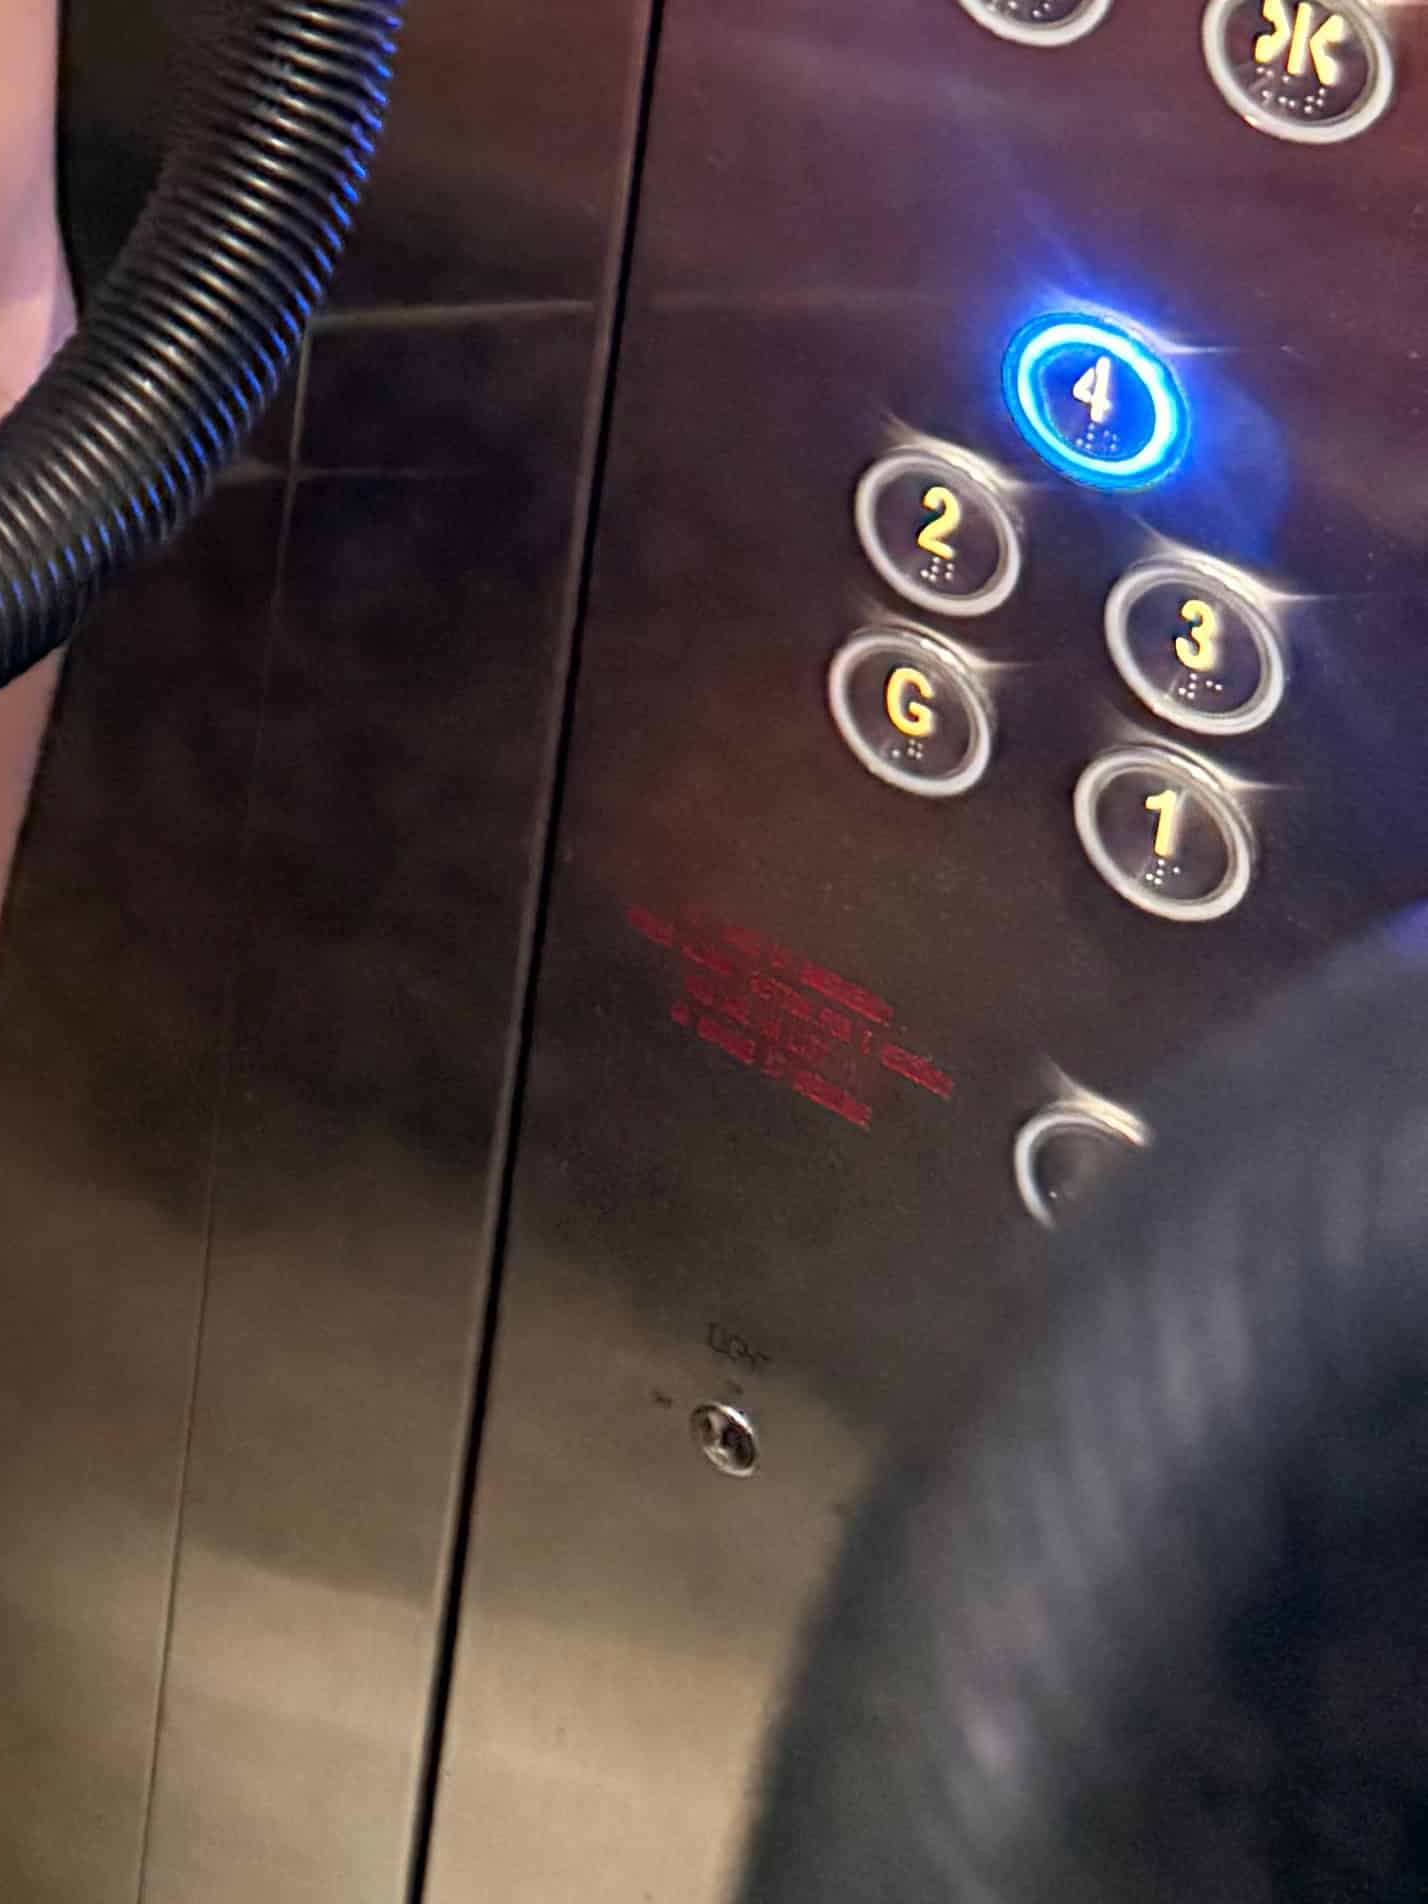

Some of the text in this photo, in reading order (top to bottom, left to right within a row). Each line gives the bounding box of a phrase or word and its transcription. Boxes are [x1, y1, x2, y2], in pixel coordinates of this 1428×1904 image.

[1072, 354, 1113, 424] 4
[917, 485, 961, 560] 2
[1174, 597, 1219, 672] 3
[885, 666, 934, 738] G
[1144, 788, 1178, 859] 1
